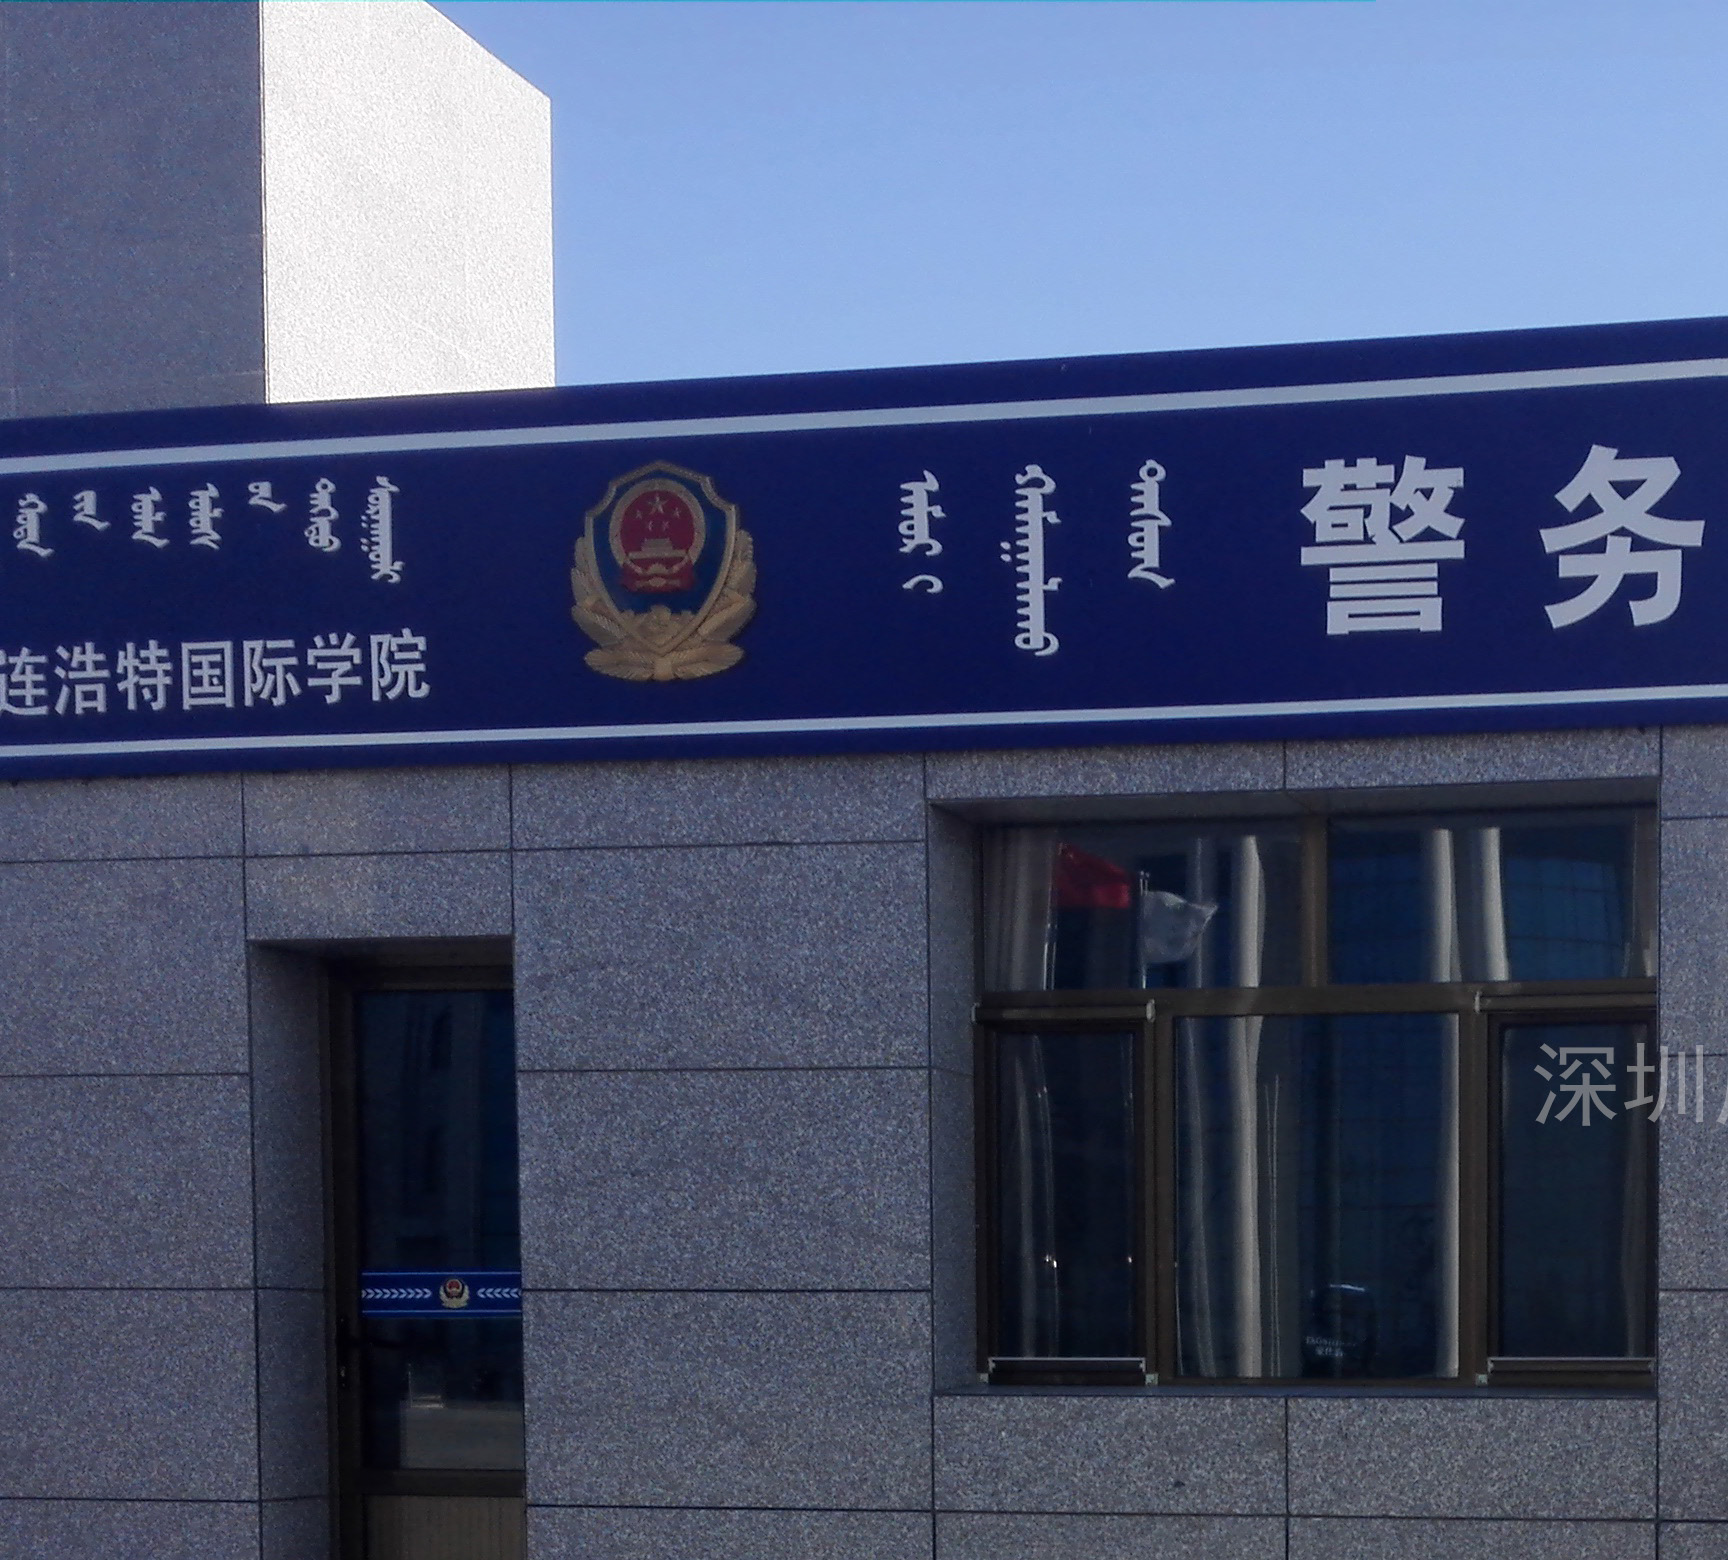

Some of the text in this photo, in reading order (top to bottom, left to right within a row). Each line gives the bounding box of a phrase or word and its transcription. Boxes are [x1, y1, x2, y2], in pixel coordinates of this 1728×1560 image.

[0, 628, 430, 716] 连浩特国际学院
